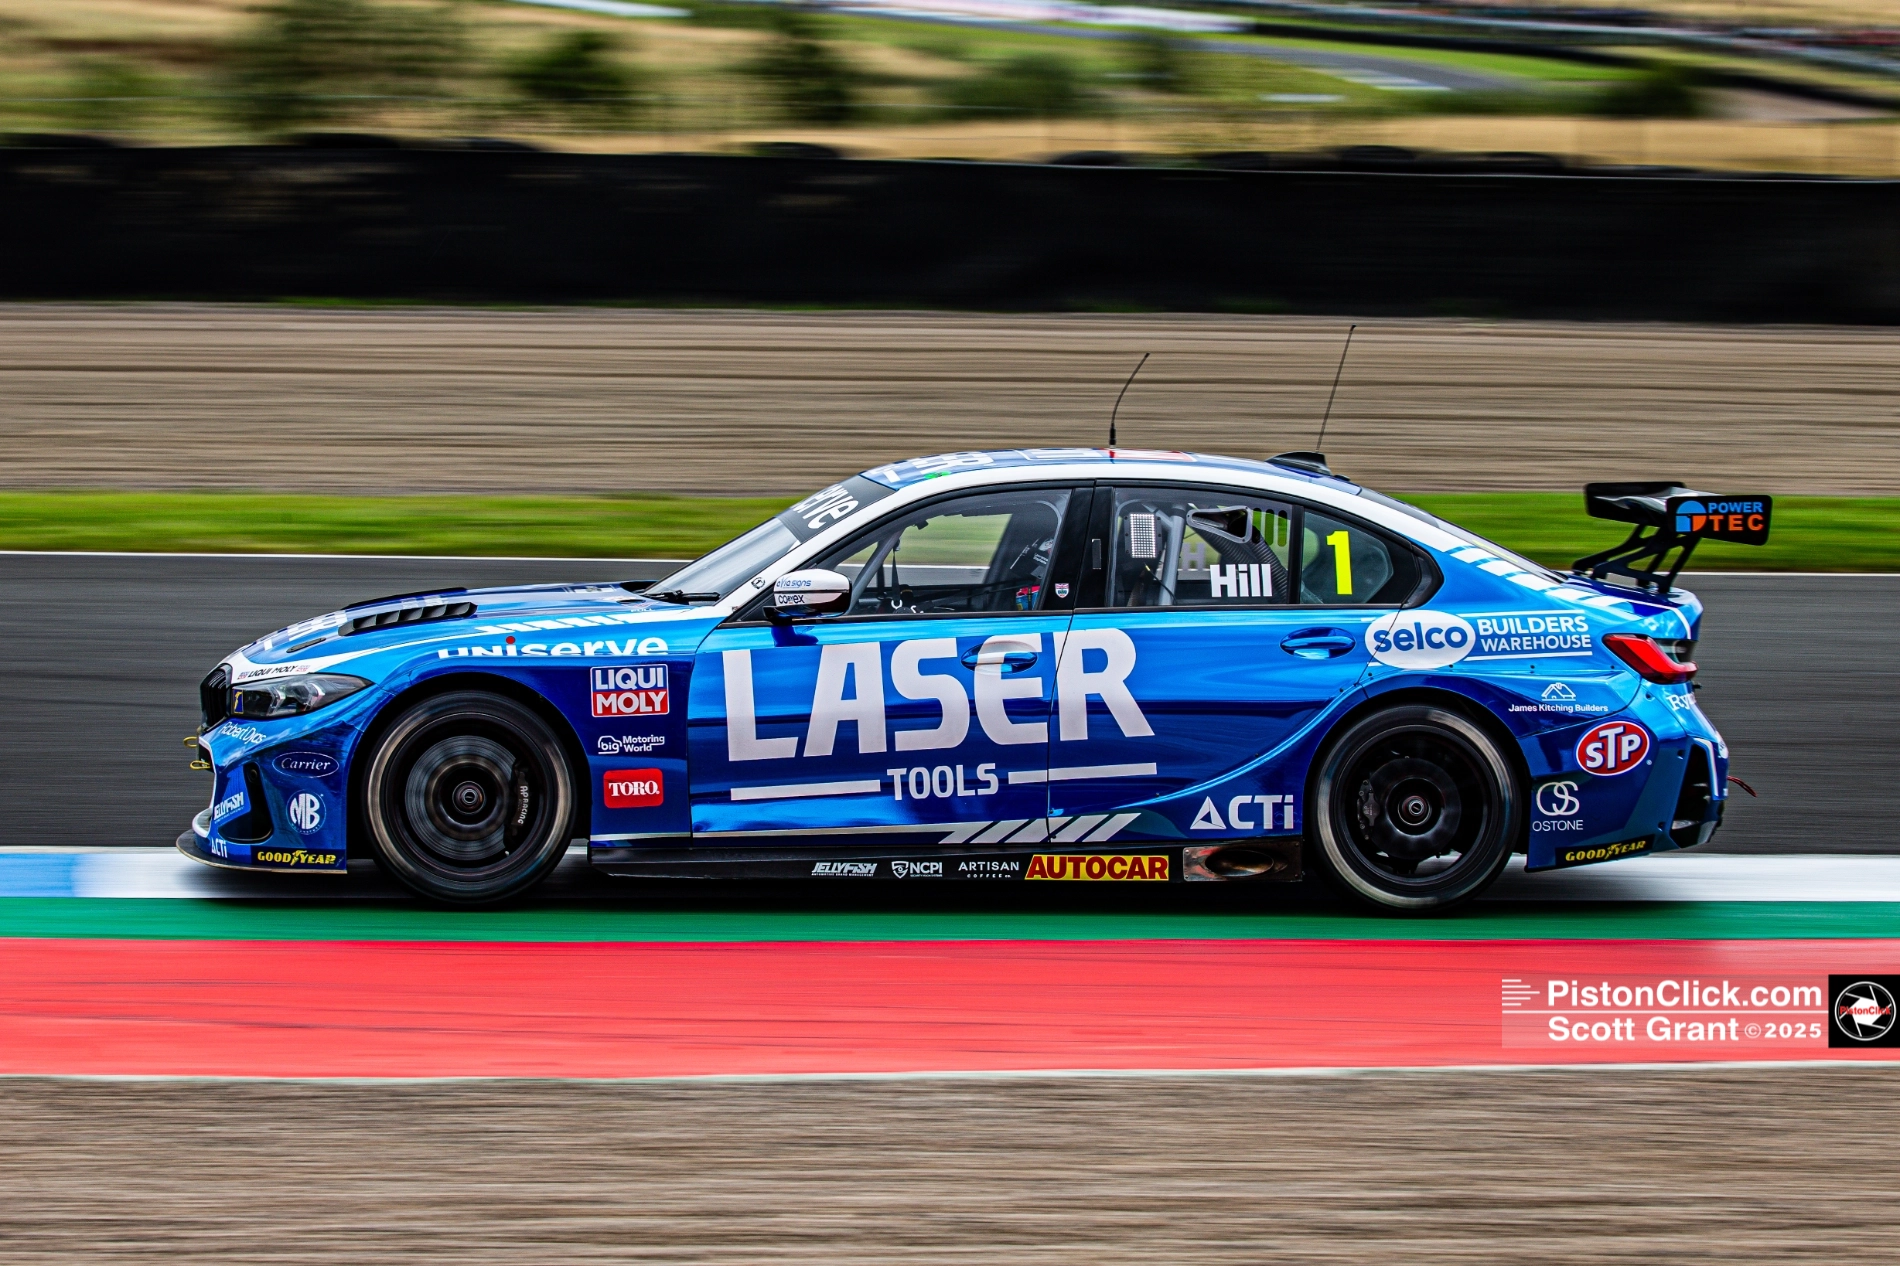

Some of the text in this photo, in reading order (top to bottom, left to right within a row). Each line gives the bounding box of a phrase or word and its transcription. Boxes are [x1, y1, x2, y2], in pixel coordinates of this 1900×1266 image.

[1708, 502, 1764, 513] POWER
[1709, 515, 1764, 531] TEC
[1326, 531, 1353, 595] 1
[1210, 564, 1273, 597] Hill
[1477, 616, 1589, 635] BUILDERS
[1373, 622, 1469, 652] selco
[1480, 634, 1592, 652] WAREHOUSE
[595, 667, 664, 691] LIQUI
[597, 691, 667, 714] MOLY
[722, 628, 1155, 762] LASER
[1508, 704, 1609, 714] James Kitching Builders
[218, 721, 250, 740] Robert
[622, 734, 665, 745] Motoring
[601, 739, 619, 753] big
[624, 743, 653, 752] World
[1586, 725, 1642, 769] STP
[281, 757, 331, 771] Carrier
[887, 762, 999, 800] TOOLS
[290, 793, 320, 830] MB
[1532, 819, 1584, 832] OSTONE
[257, 850, 337, 865] GOODYEAR
[1565, 840, 1647, 861] GOODYEAR
[811, 862, 878, 874] JELLYFISH
[909, 862, 943, 874] NCPI
[958, 861, 1020, 871] ARTISAN
[1026, 855, 1169, 880] AUTOCAR
